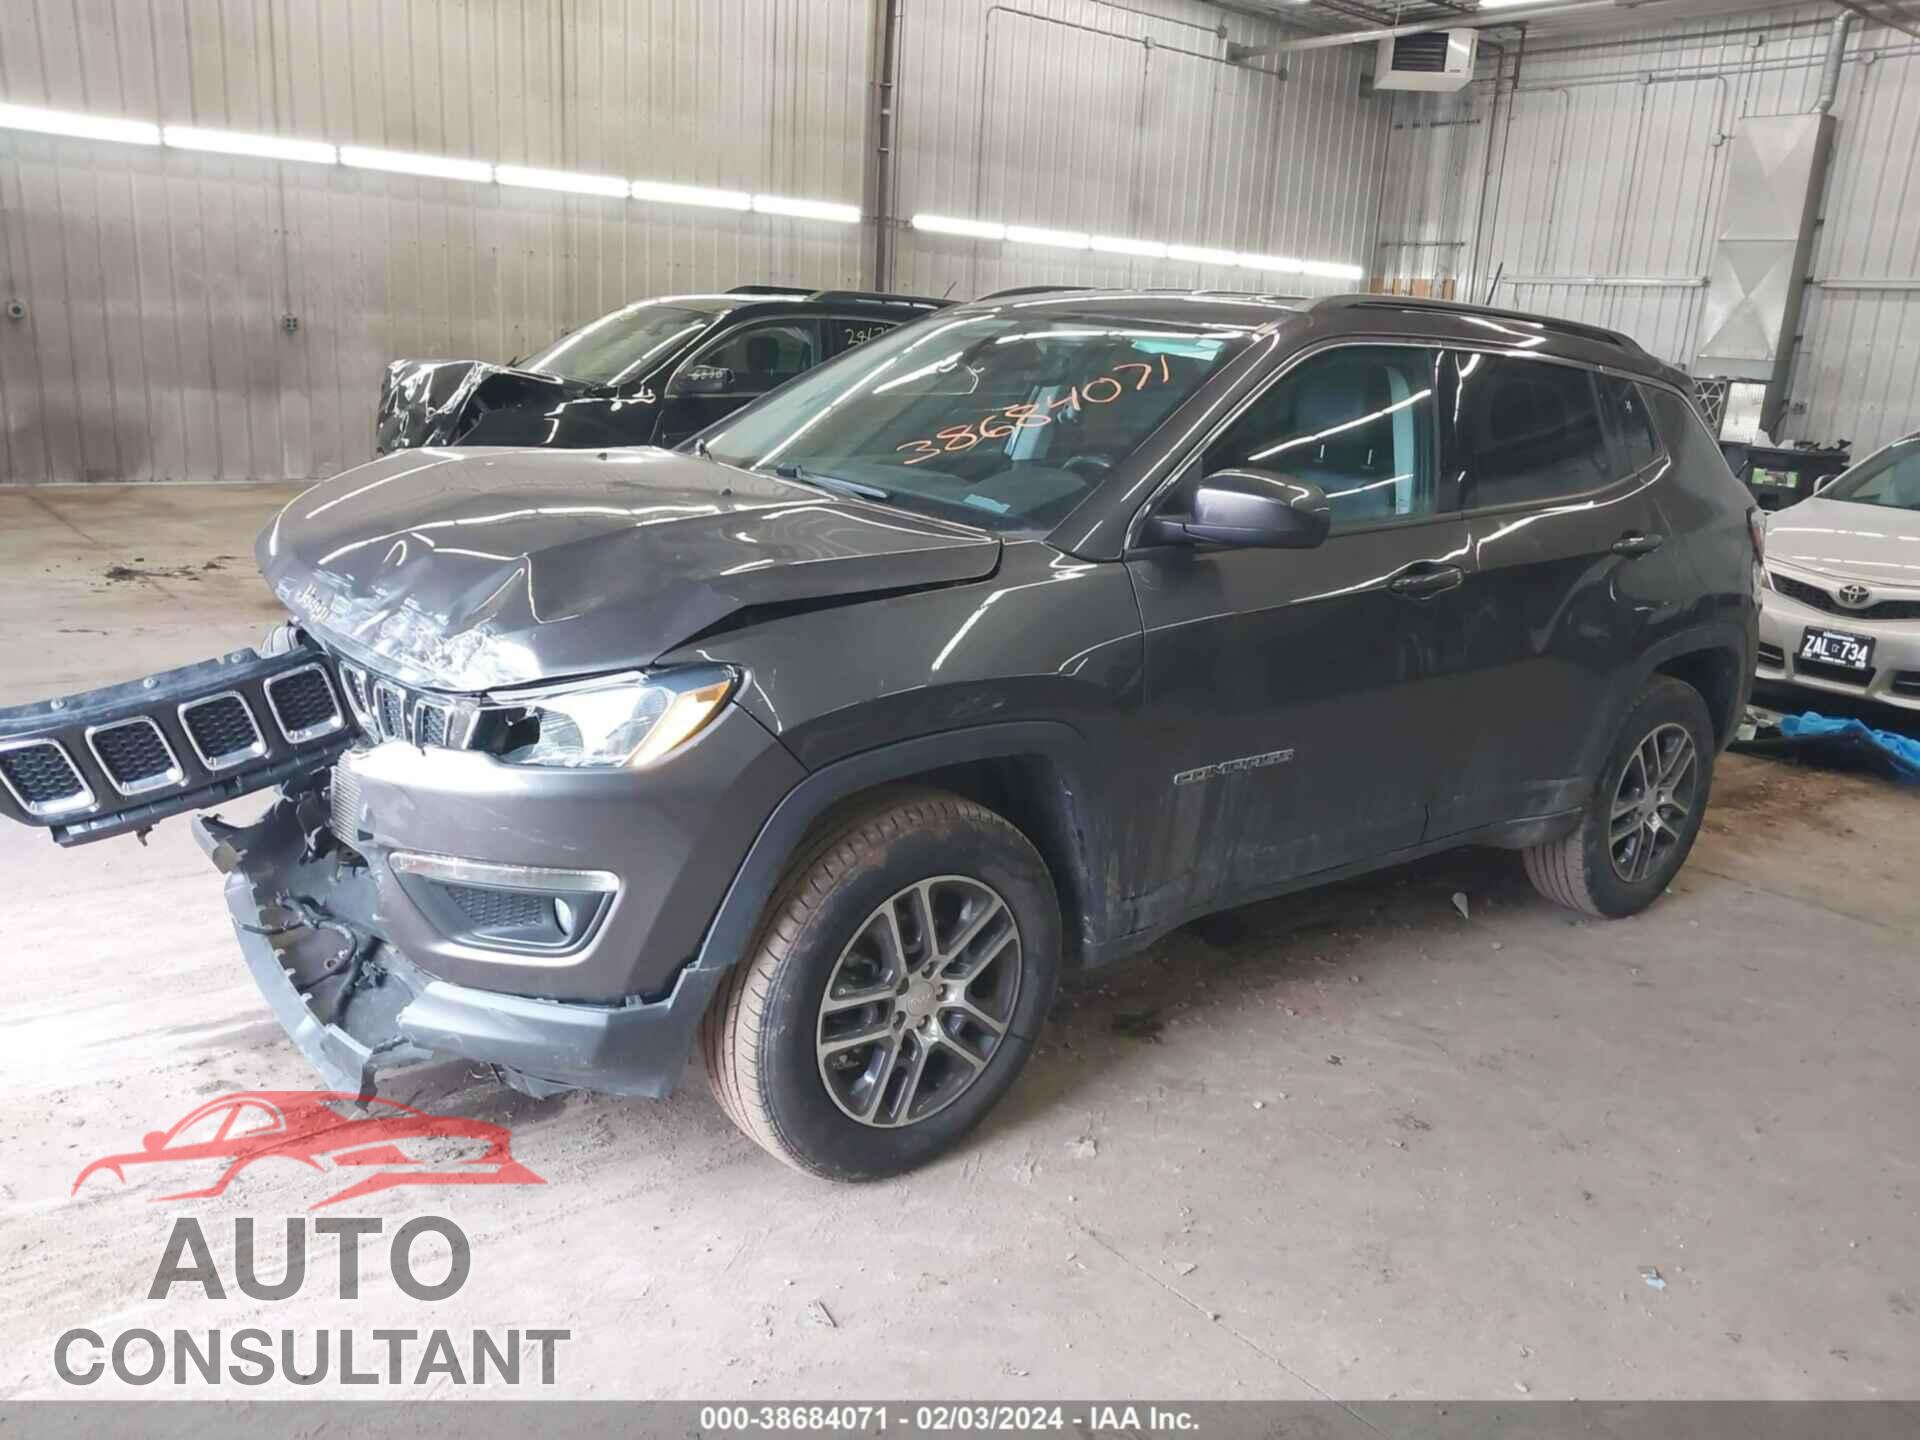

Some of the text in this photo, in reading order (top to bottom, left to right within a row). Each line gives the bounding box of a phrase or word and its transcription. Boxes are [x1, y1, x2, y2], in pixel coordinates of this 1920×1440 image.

[896, 354, 1169, 465] 38684071
[1803, 634, 1830, 656] ZAL
[1840, 640, 1869, 663] 734
